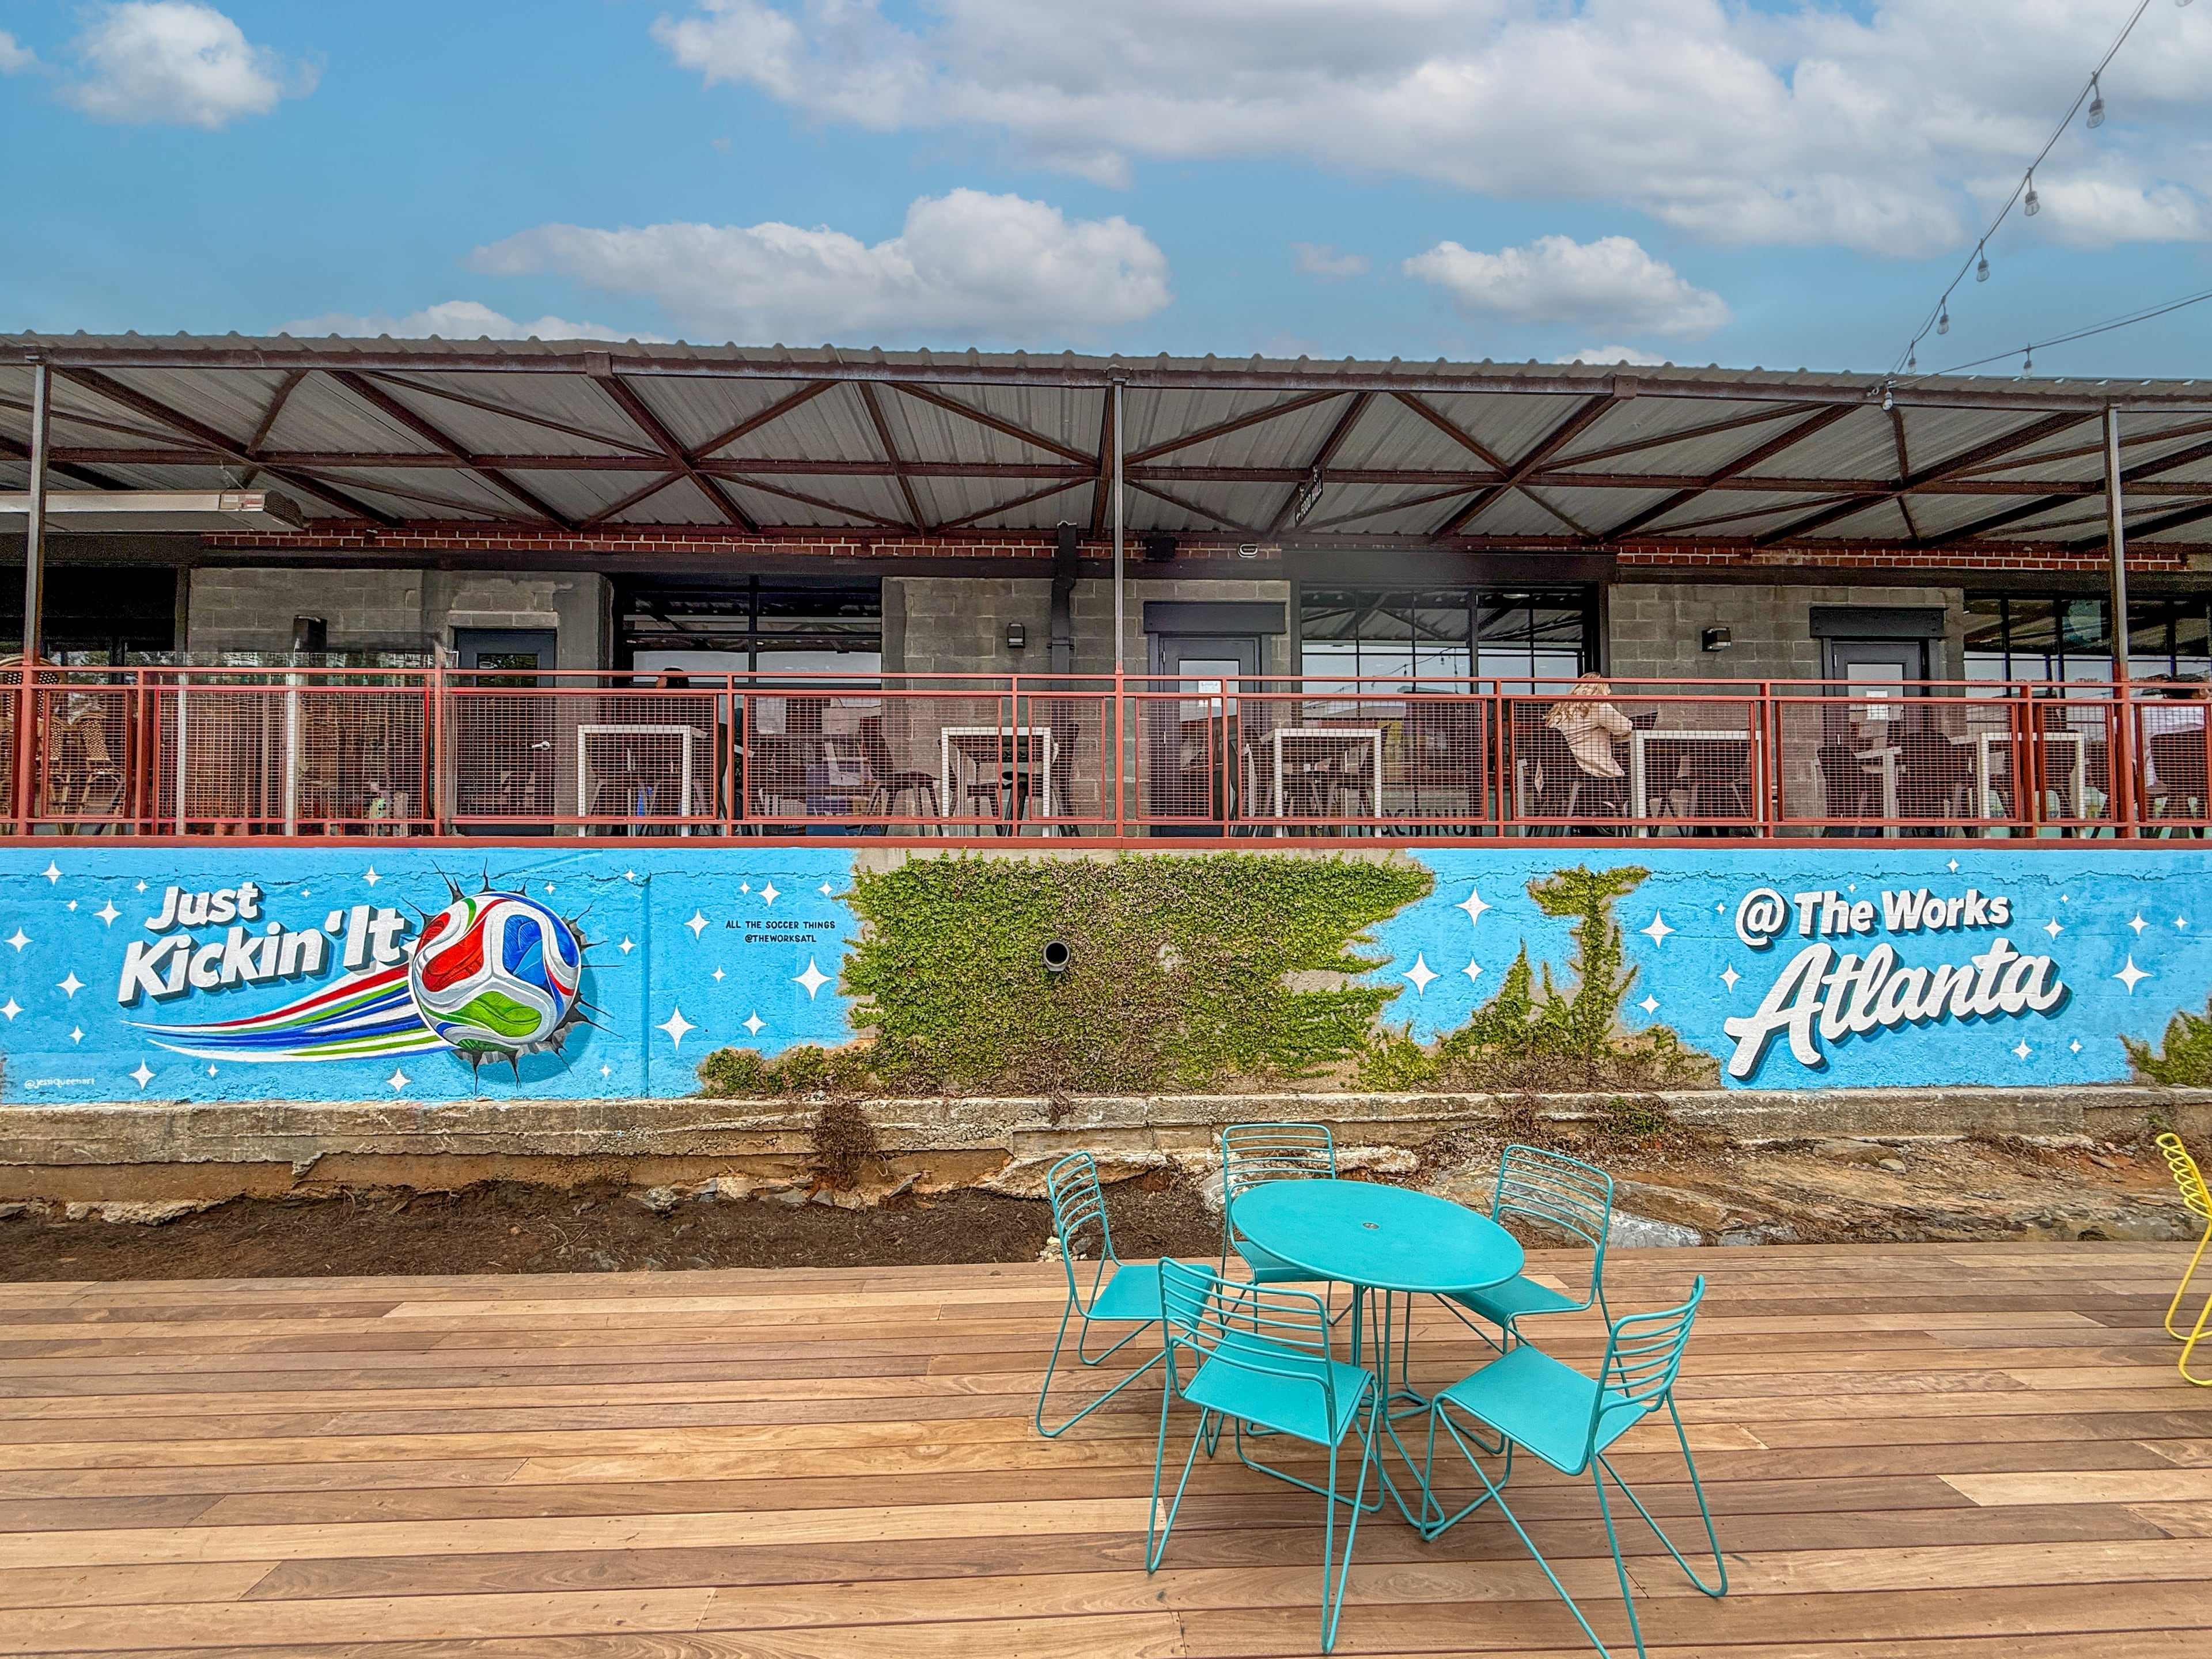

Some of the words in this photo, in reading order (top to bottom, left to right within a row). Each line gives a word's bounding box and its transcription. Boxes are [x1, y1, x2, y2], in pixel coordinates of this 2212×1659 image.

[144, 882, 261, 932] Just
[726, 921, 741, 929] ALL
[745, 921, 762, 929] THE
[766, 921, 799, 929] SOCCER
[804, 921, 835, 929] THINGS
[1735, 888, 1788, 948] @
[1794, 890, 1876, 936] The
[1881, 888, 2011, 933] Works
[745, 934, 817, 942] @THEWORKSATL
[1724, 938, 2067, 1078] Atlanta
